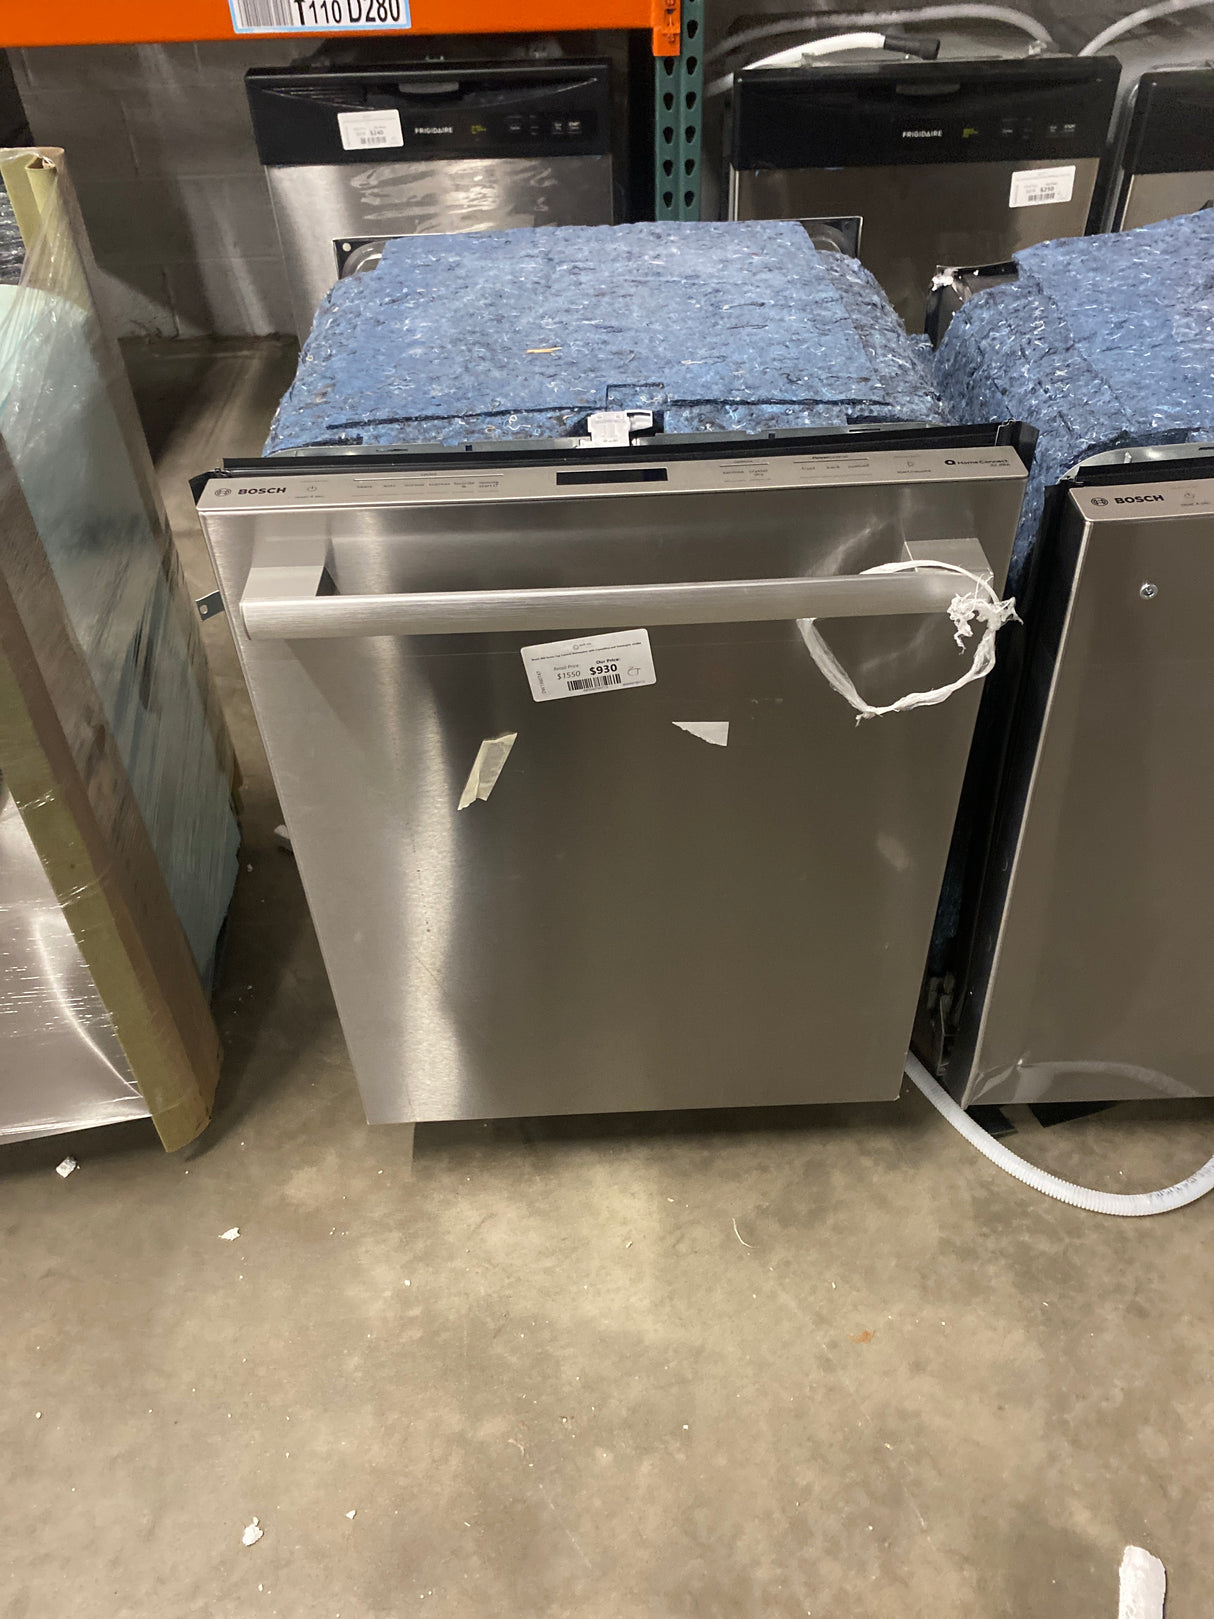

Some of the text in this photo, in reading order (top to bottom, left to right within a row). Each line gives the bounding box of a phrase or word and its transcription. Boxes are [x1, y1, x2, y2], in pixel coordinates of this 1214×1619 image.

[414, 126, 453, 134] FRIGIDAIRE
[902, 130, 942, 138] FRIGIDAIRE
[238, 487, 287, 495] BOSCH
[1114, 495, 1165, 504] BOSCH
[589, 663, 618, 676] $930
[557, 670, 581, 680] $1550
